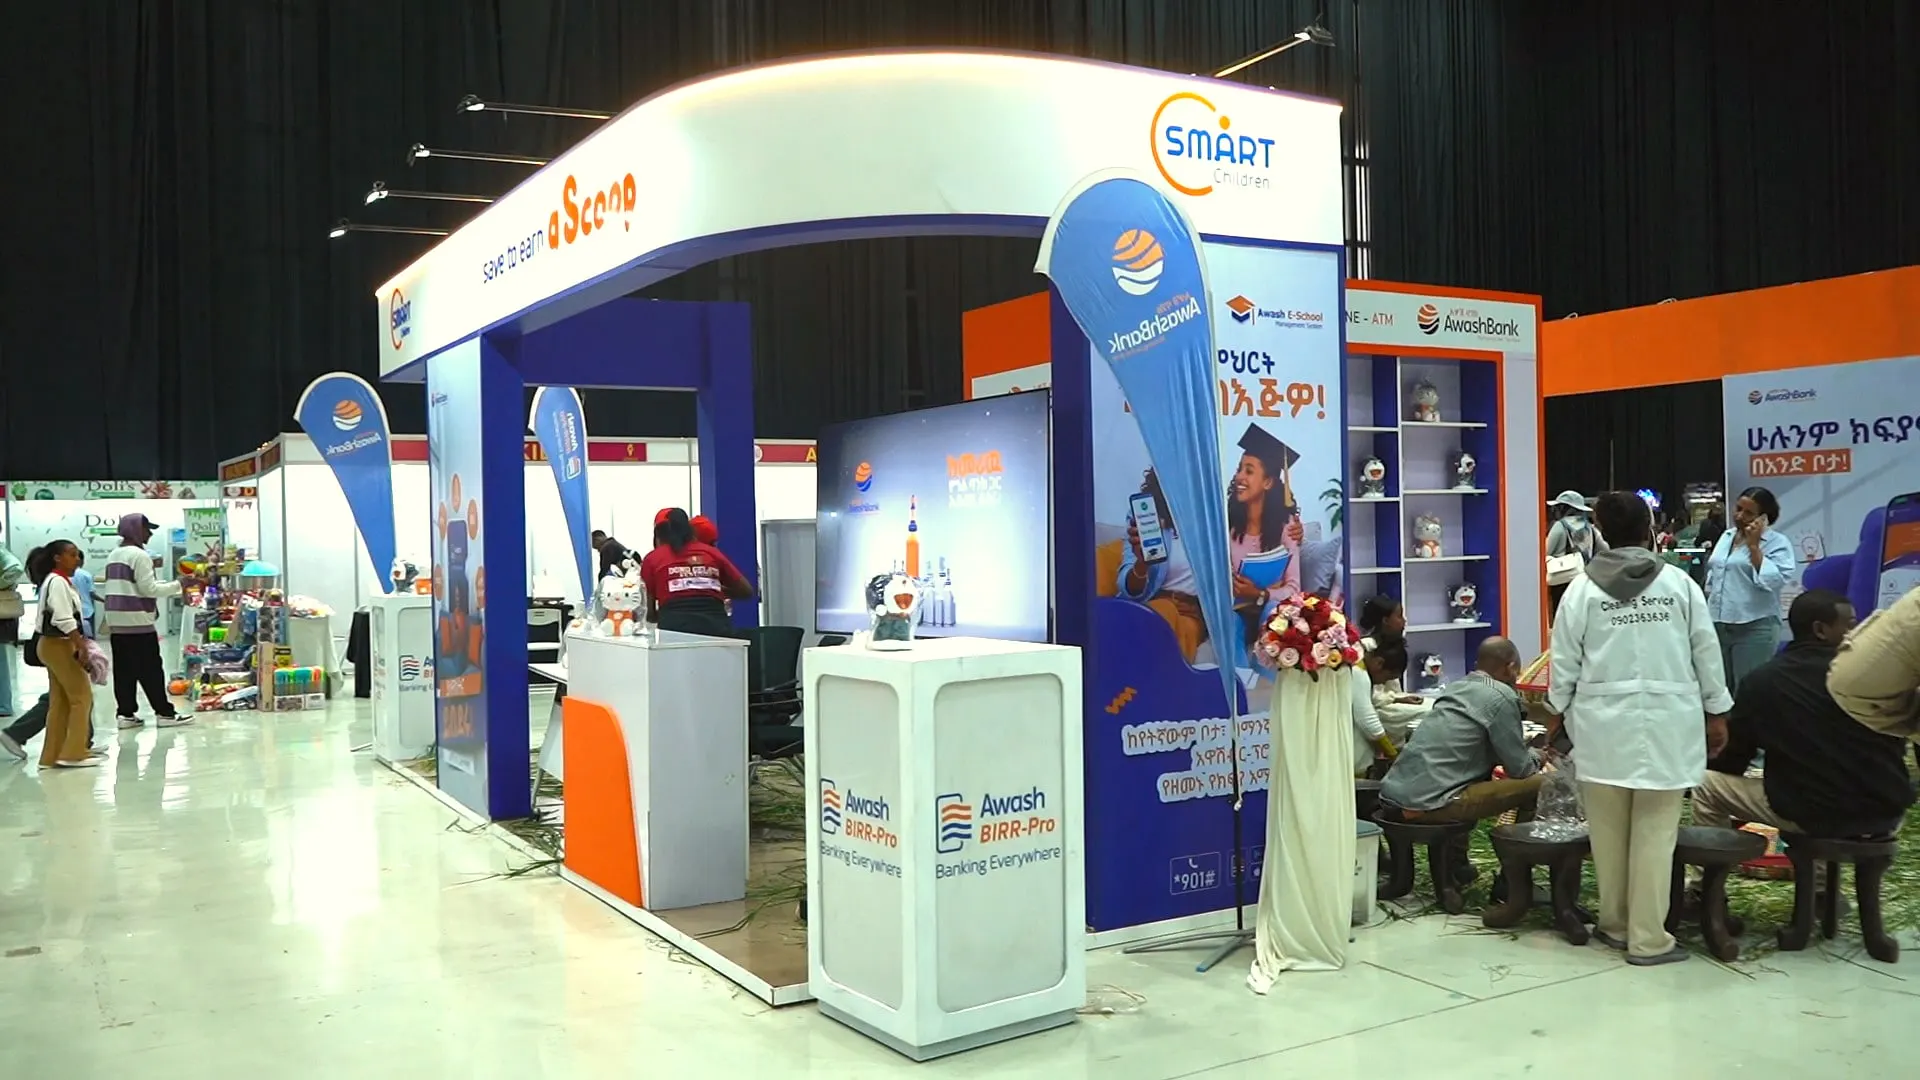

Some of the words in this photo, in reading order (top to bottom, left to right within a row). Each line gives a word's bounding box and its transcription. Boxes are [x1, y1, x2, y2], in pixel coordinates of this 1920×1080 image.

[1166, 125, 1275, 168] SMART
[1214, 168, 1270, 189] Children
[483, 256, 504, 284] save
[507, 246, 517, 269] to
[520, 229, 544, 263] earn
[548, 210, 559, 250] a
[563, 173, 637, 245] Scoop
[1258, 308, 1285, 318] Awash
[1287, 310, 1323, 321] E-School
[1372, 312, 1393, 326] ATM
[1444, 315, 1519, 337] AwashBank
[1748, 421, 1839, 451] ሁሉንም
[1849, 415, 1920, 445] ክፍያ
[1812, 453, 1848, 472] ቦታ!
[1601, 598, 1638, 611] Cleag
[1641, 595, 1675, 606] Service
[1127, 726, 1196, 749] ከየትኛውም
[845, 789, 890, 821] Awash
[980, 786, 1045, 818] Awash
[845, 818, 898, 849] BIRR-Pro
[980, 817, 1056, 844] BIRR-Pro
[821, 840, 851, 866] Banking
[851, 850, 902, 878] Everywhere
[936, 855, 987, 879] Banking
[990, 846, 1061, 870] Everywhere
